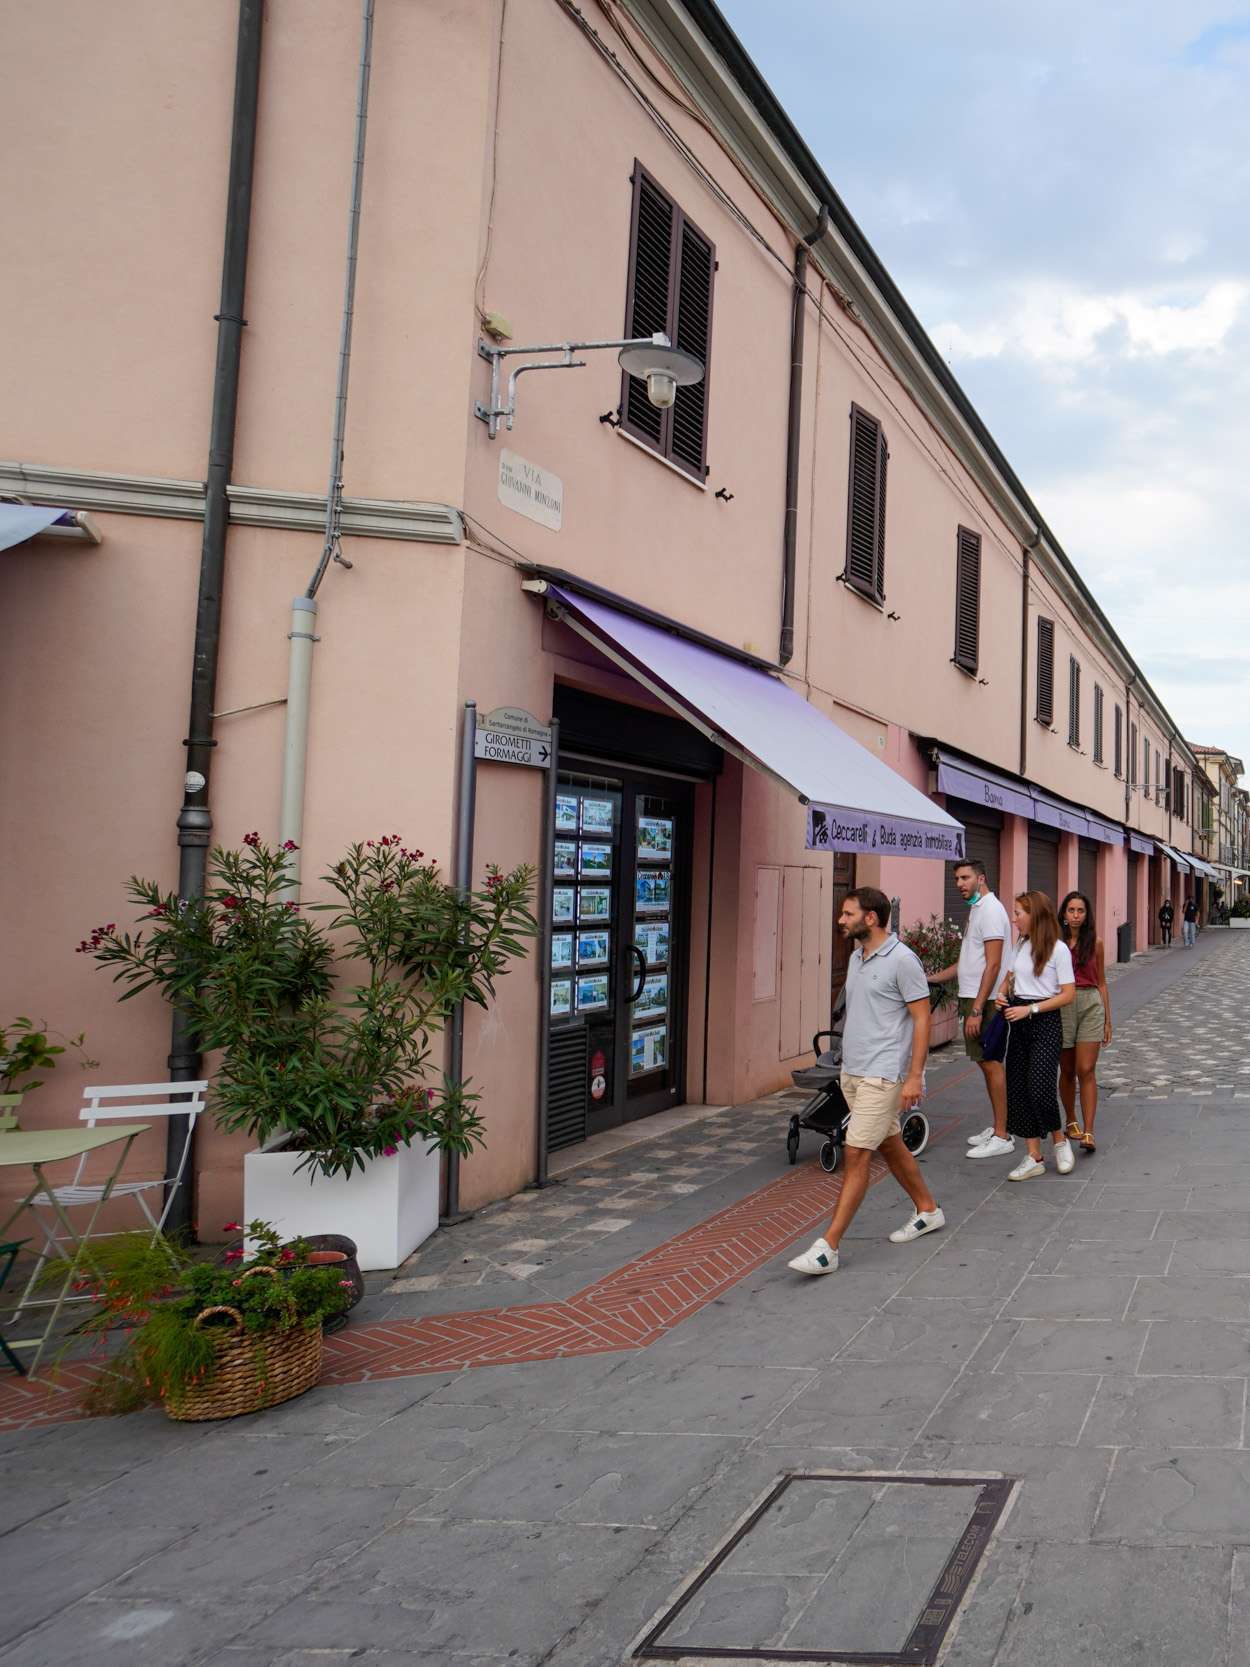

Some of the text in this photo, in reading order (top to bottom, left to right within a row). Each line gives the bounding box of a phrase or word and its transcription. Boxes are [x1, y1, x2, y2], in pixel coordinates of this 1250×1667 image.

[523, 463, 542, 487] VIA
[501, 472, 561, 513] GIOVANNI MINZONI
[484, 745, 532, 763] FORMAGGI
[485, 732, 532, 751] GIROMETTI
[830, 818, 868, 844] Ceccarelli
[880, 825, 897, 846] Buda
[899, 830, 923, 851] agenzia
[955, 1524, 981, 1566] TELECOM
